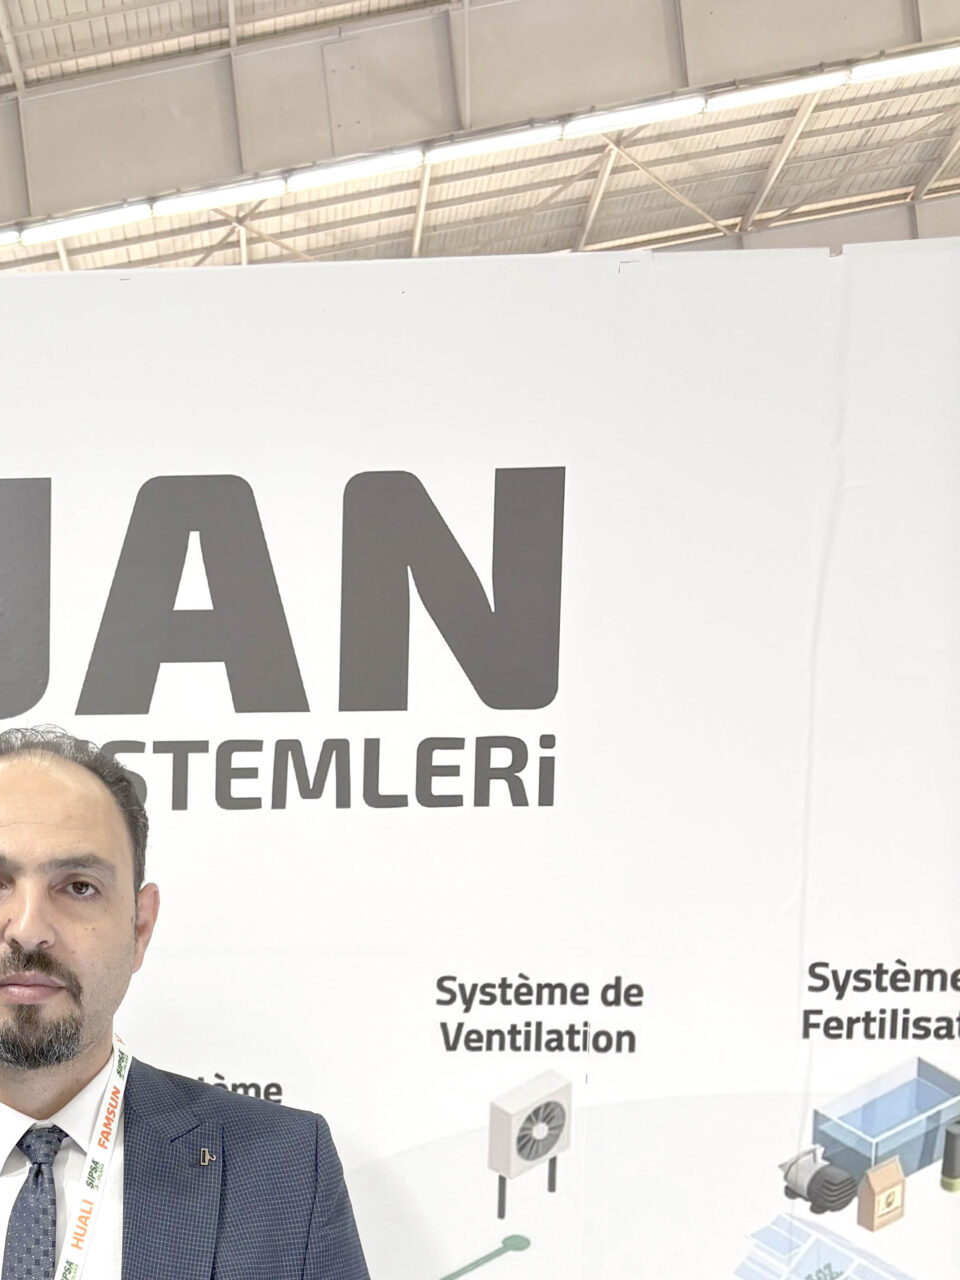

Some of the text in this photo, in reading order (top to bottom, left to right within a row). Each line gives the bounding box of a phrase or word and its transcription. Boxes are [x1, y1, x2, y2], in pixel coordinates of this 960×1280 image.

[437, 973, 644, 1008] Système de
[440, 1022, 635, 1053] Ventilation
[97, 1085, 121, 1150] FAMSUN
[85, 1157, 100, 1188] SIPSA
[71, 1199, 95, 1251] HUALI
